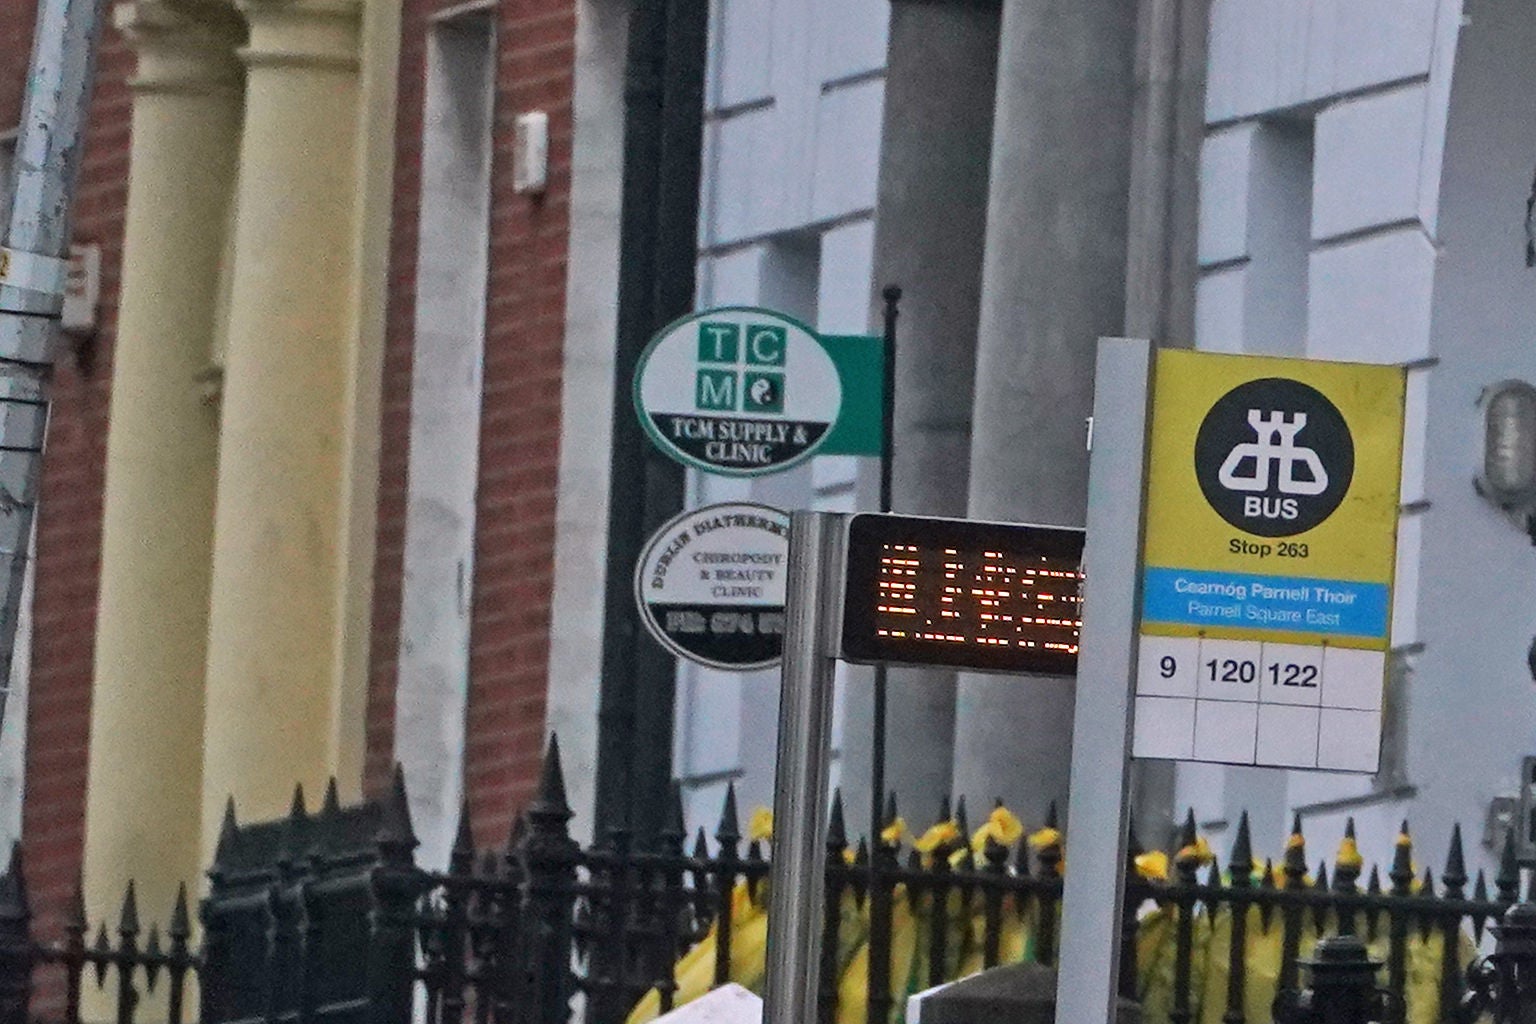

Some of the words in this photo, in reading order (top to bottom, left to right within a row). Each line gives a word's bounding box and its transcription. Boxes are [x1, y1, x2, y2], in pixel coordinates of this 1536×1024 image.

[672, 416, 715, 440] TCM
[718, 421, 790, 444] SUPPLY
[793, 425, 808, 445] &
[704, 441, 772, 464] CLINIC
[1243, 496, 1299, 520] BUS
[1229, 538, 1272, 559] Stop
[1277, 542, 1309, 559] 263
[715, 569, 775, 582] BEAUTY
[711, 586, 763, 599] CLINIC
[1174, 577, 1247, 601] Cearnóg
[1252, 582, 1310, 602] Parnell
[1315, 587, 1358, 605] Thoir
[1187, 600, 1241, 619] Parnell
[1246, 605, 1301, 624] Square
[1306, 608, 1341, 626] East
[1159, 655, 1177, 679] 9
[1205, 658, 1256, 684] 120
[1267, 664, 1319, 688] 122
